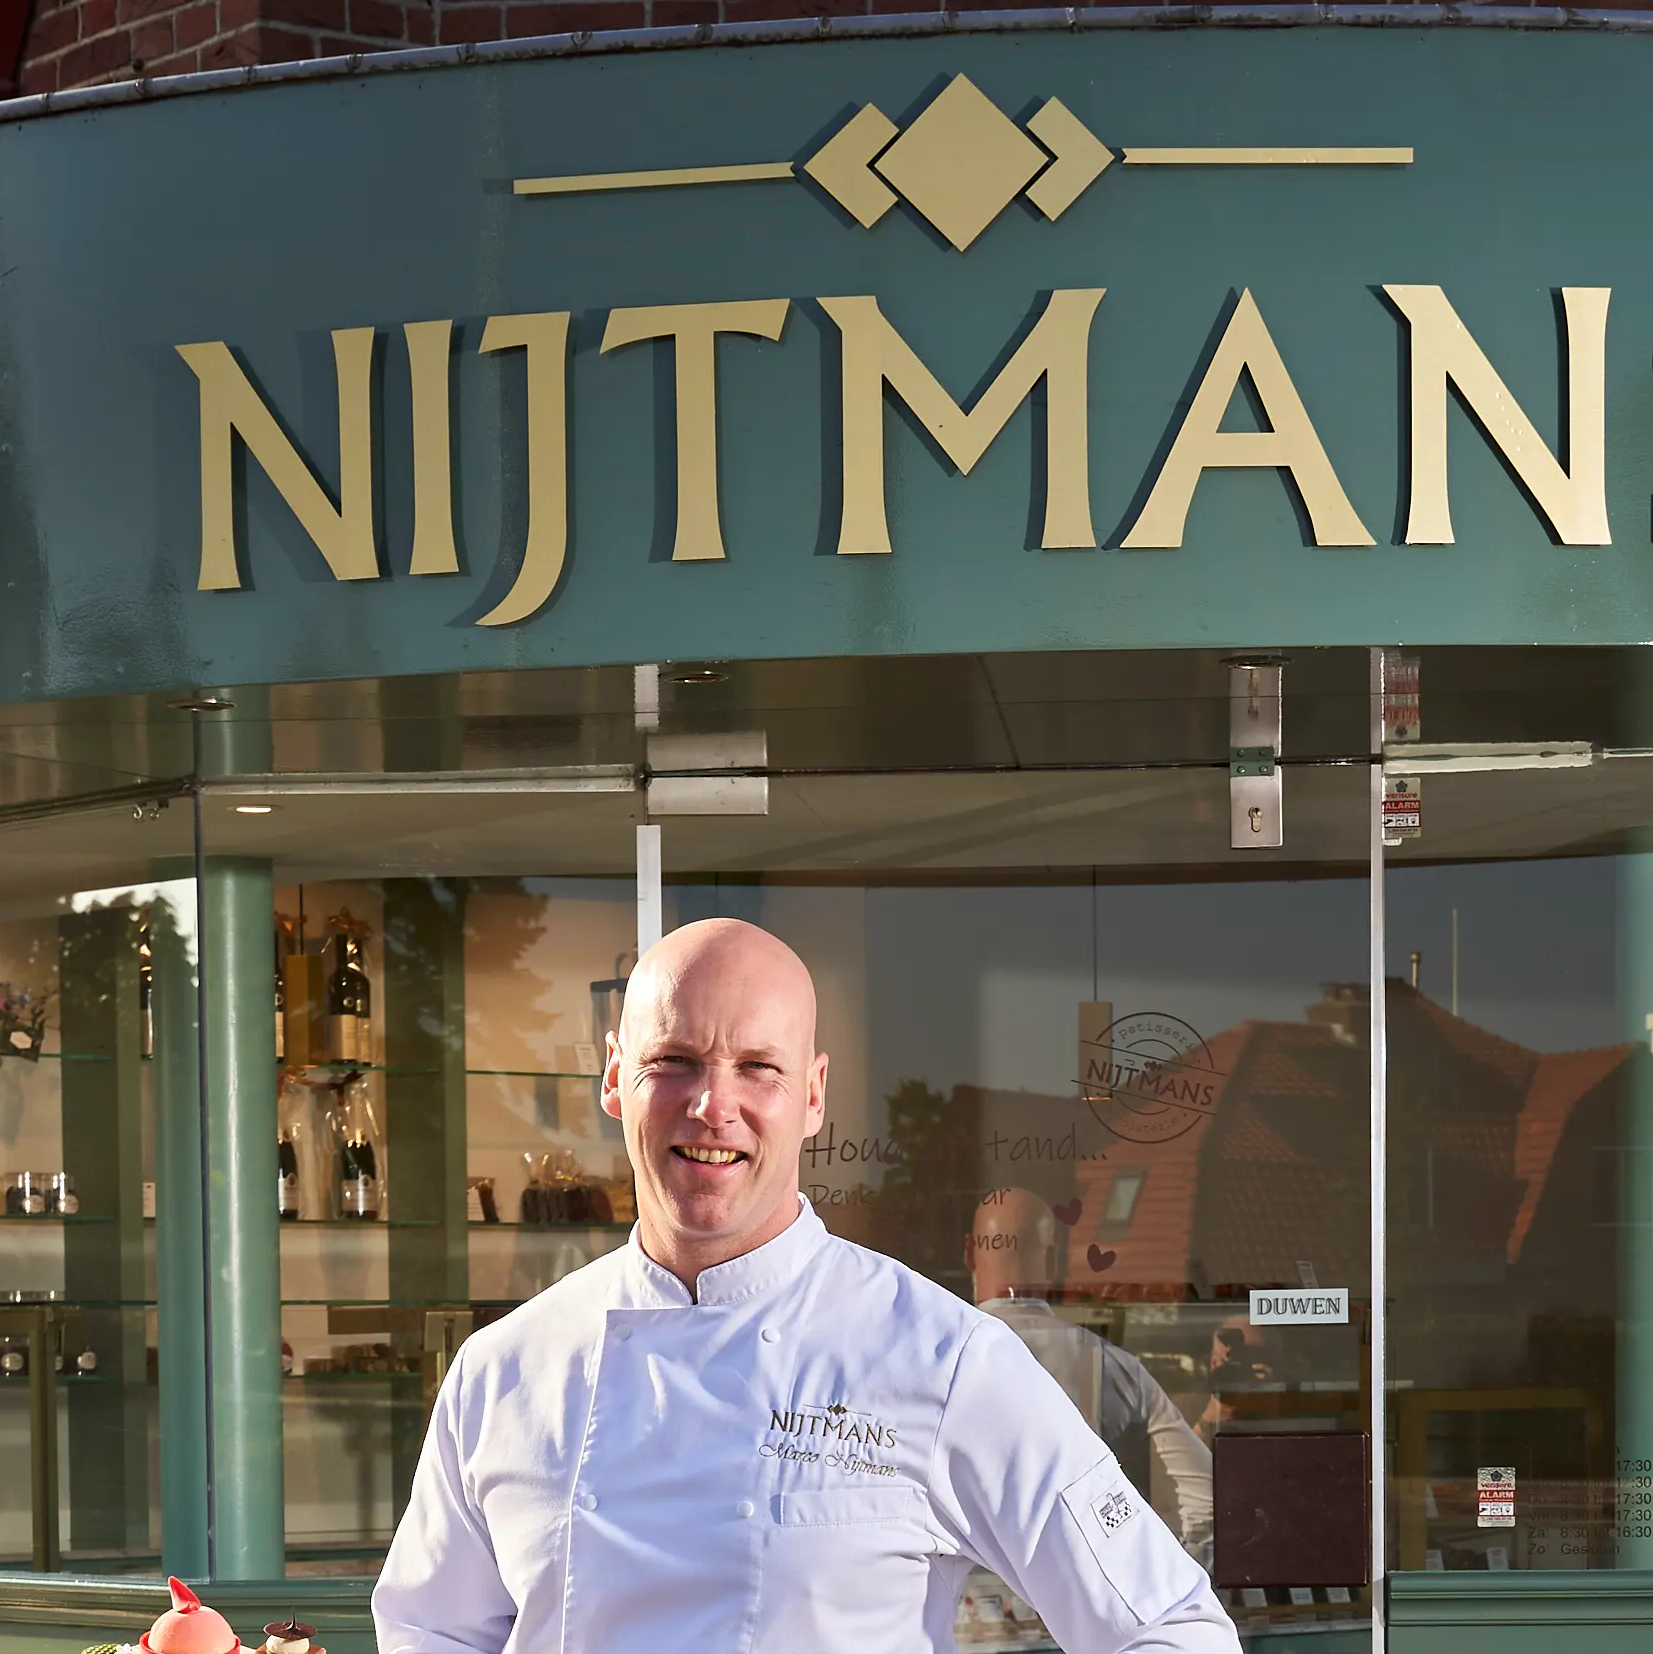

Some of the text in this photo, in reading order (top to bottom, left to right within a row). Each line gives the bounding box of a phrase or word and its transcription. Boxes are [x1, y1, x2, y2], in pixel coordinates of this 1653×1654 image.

[1385, 802, 1419, 810] ALARM
[1086, 1058, 1215, 1106] NIJTMANS
[807, 1183, 878, 1208] Denk
[1256, 1297, 1342, 1315] DUWEN
[769, 1409, 898, 1449] NIJTMANS
[759, 1442, 820, 1464] Marco
[1616, 1459, 1652, 1472] 17:30
[1479, 1491, 1514, 1499] ALARM
[1616, 1492, 1652, 1504] 17:30
[1616, 1509, 1652, 1521] 17:30
[1560, 1526, 1589, 1538] 8:30
[1616, 1526, 1652, 1538] 16:30
